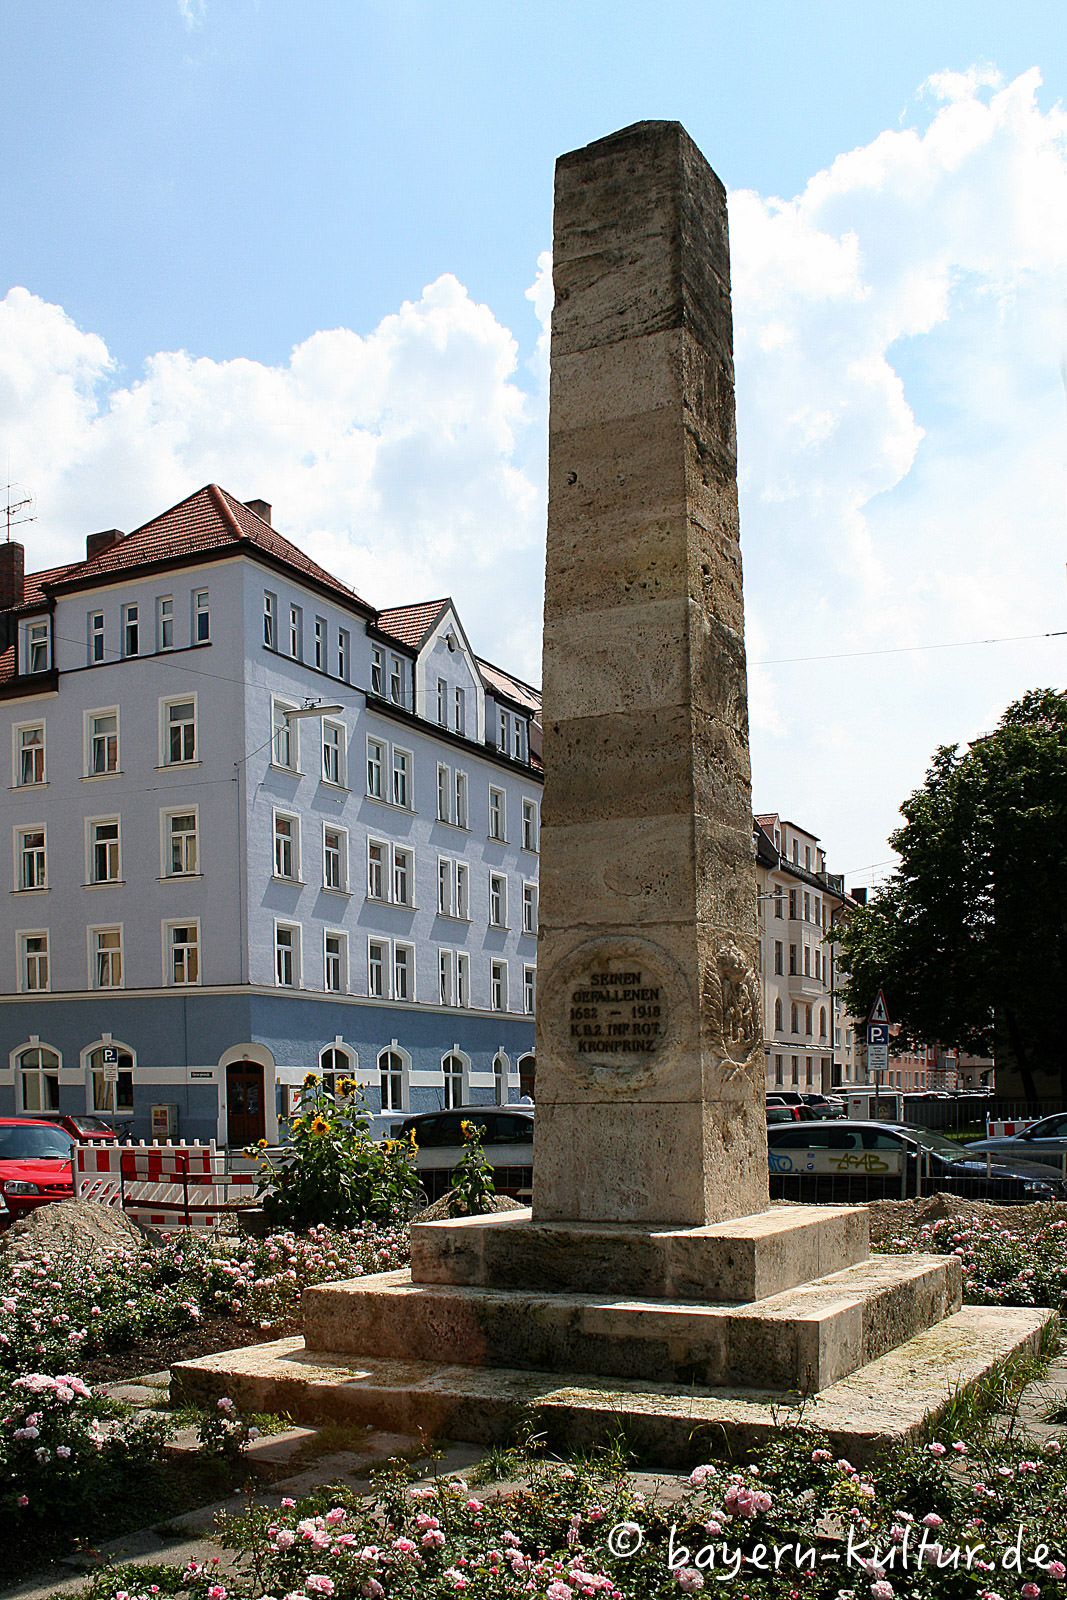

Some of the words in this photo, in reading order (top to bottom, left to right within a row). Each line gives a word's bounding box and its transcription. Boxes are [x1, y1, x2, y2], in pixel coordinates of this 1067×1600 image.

[591, 972, 641, 985] SEINEN
[572, 989, 659, 1003] GEFALLENEN
[570, 1007, 598, 1021] 1682
[631, 1005, 662, 1019] 1918
[871, 1027, 883, 1043] P
[578, 1040, 656, 1053] KRONPRINZ
[105, 1049, 113, 1061] P
